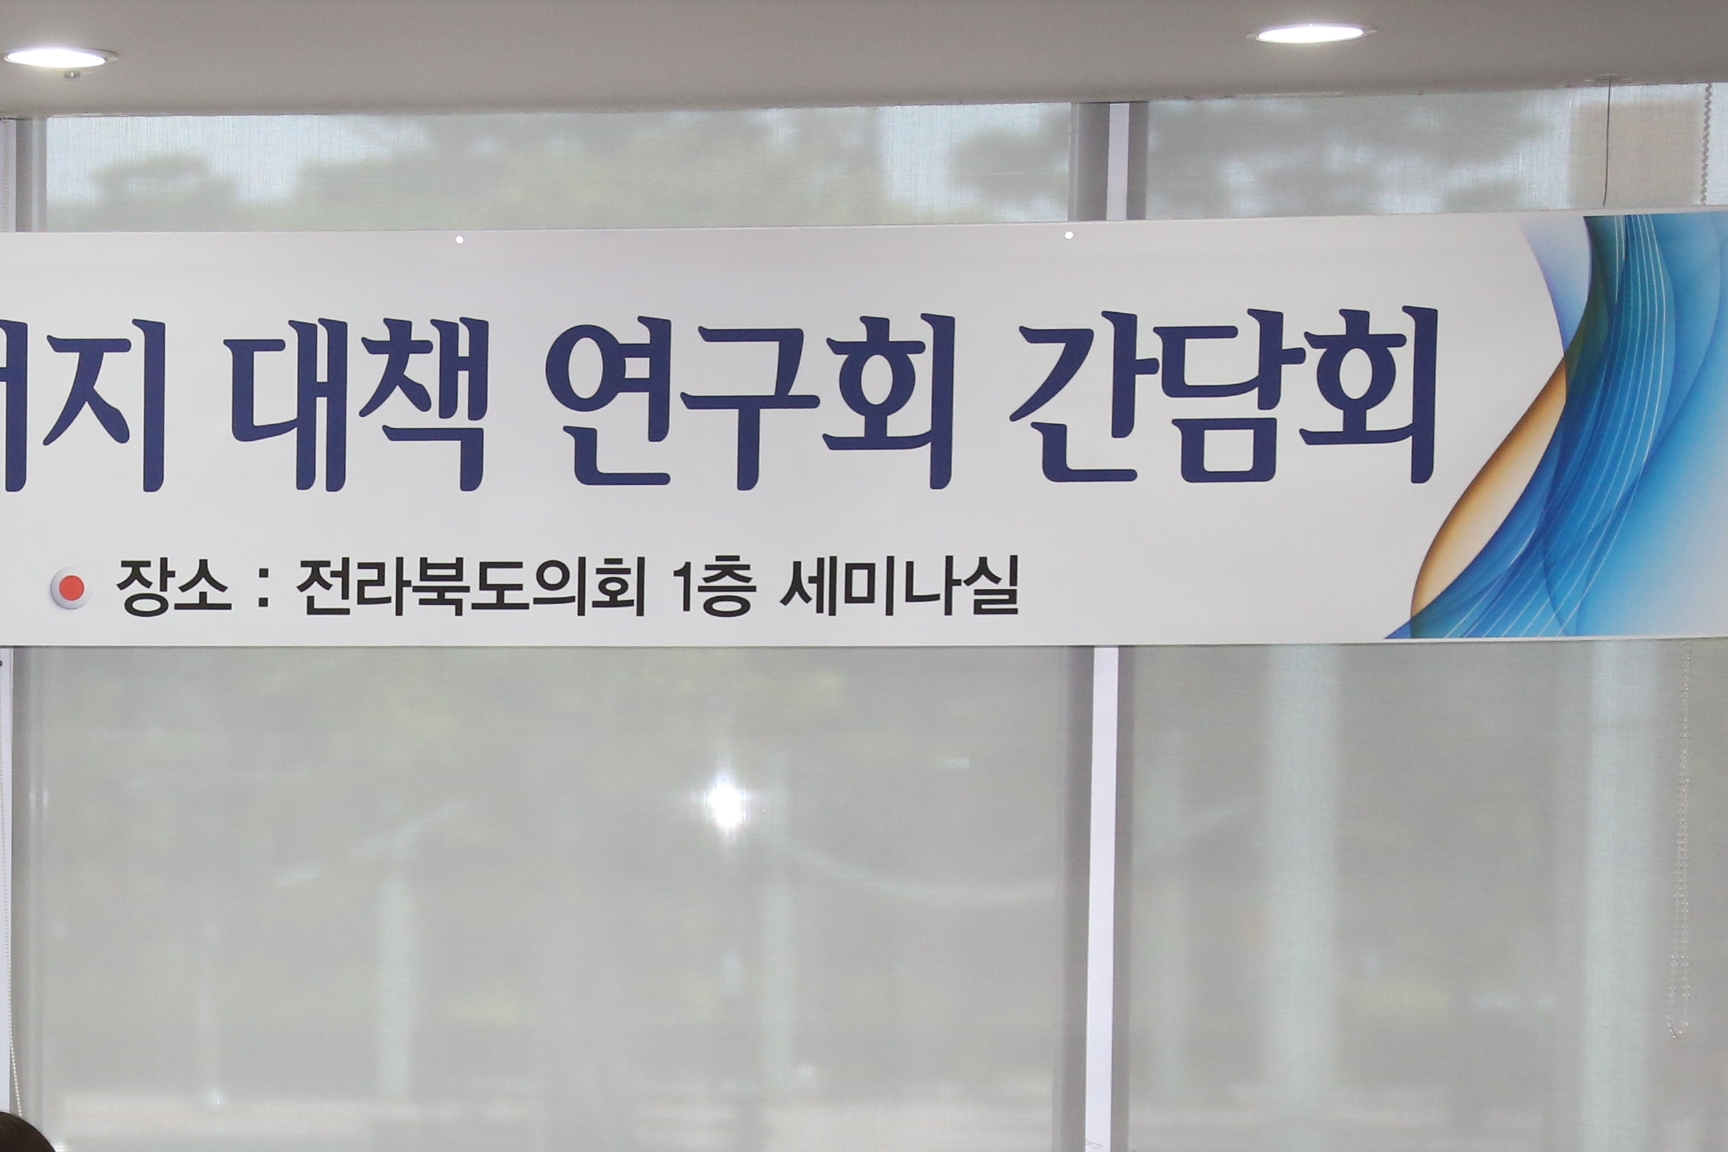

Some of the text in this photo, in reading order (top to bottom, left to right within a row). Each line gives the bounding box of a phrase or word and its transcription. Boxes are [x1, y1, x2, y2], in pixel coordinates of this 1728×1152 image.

[223, 317, 489, 492] 대책
[546, 313, 955, 490] 연구회
[1010, 306, 1439, 485] 간담회
[117, 557, 231, 617] 장소
[297, 557, 645, 616] 전라북도의회
[674, 555, 756, 617] 1층
[780, 555, 1018, 616] 세미나실
